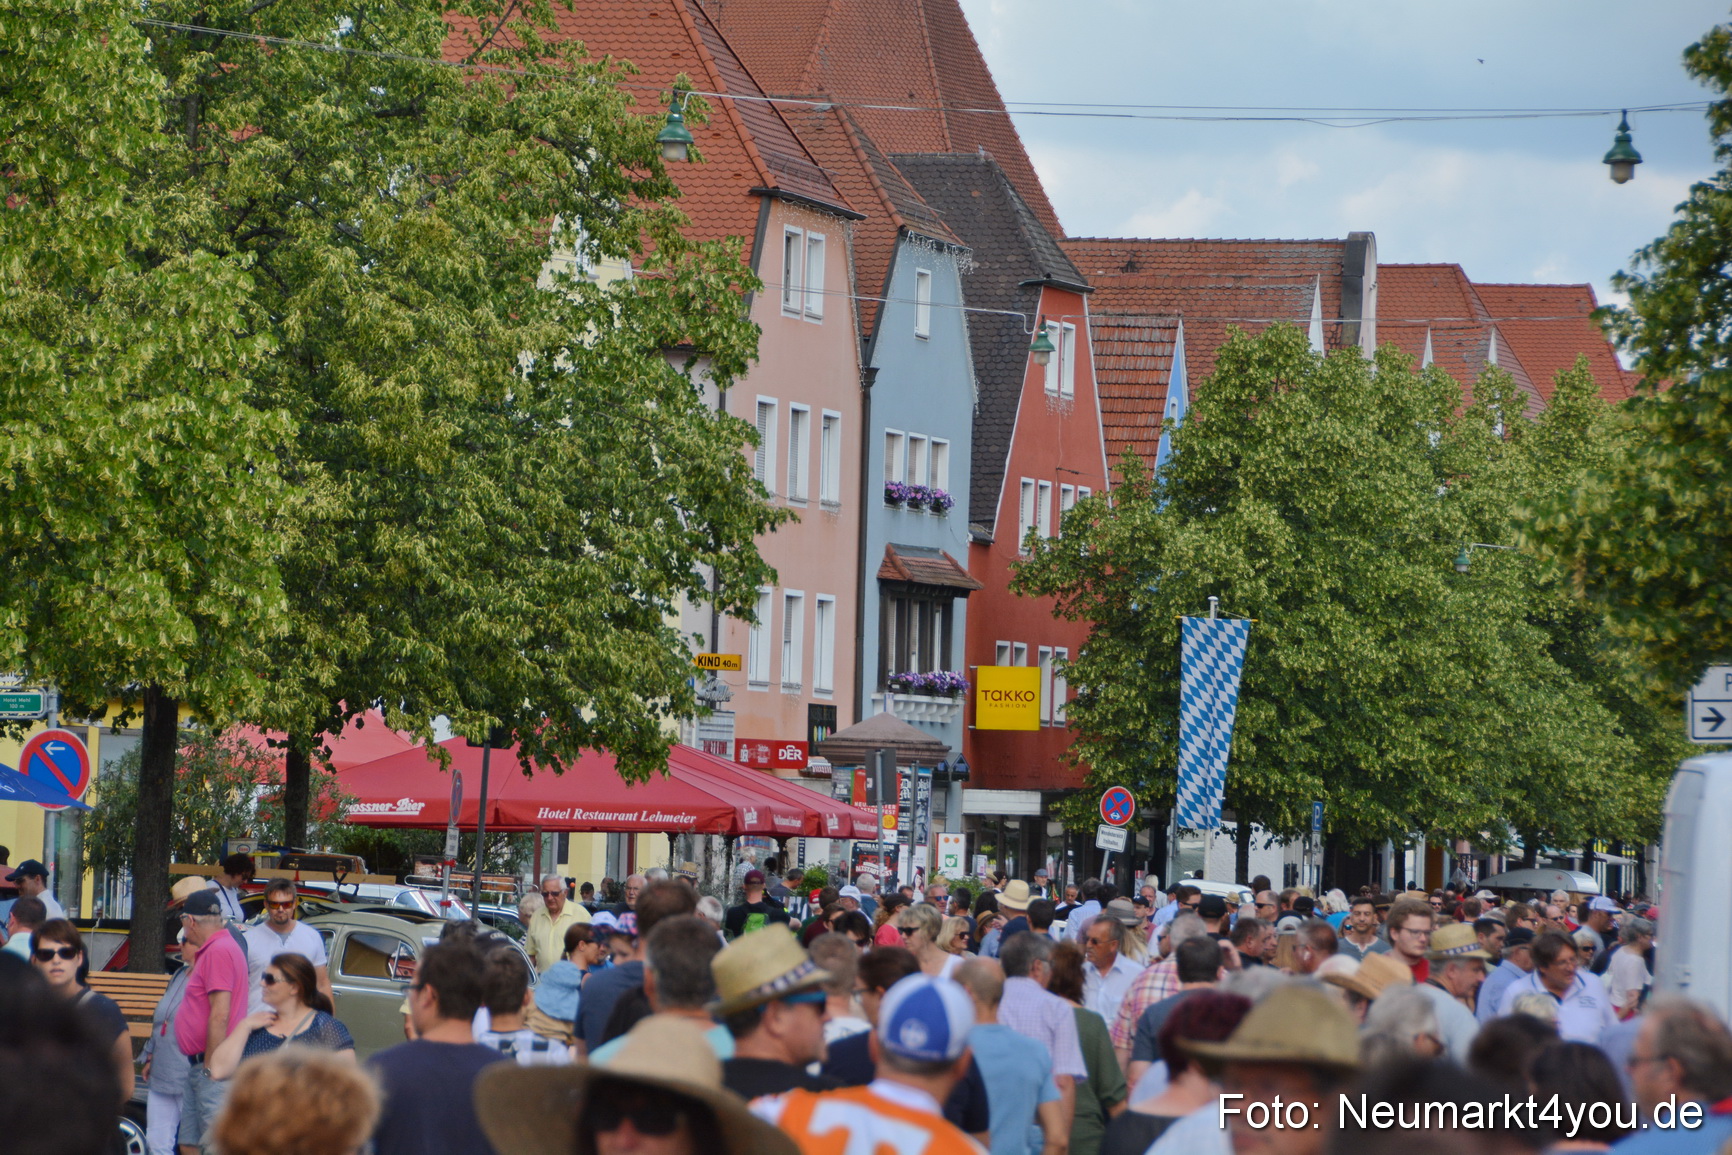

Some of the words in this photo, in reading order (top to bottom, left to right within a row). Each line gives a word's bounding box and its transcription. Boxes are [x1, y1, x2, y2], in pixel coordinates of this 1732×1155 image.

[697, 655, 721, 667] KINO
[340, 798, 425, 812] lossner-Bier
[537, 807, 571, 819] Hotel
[572, 808, 639, 821] Restaurant
[640, 810, 697, 824] Lehmeier
[1314, 805, 1320, 826] P
